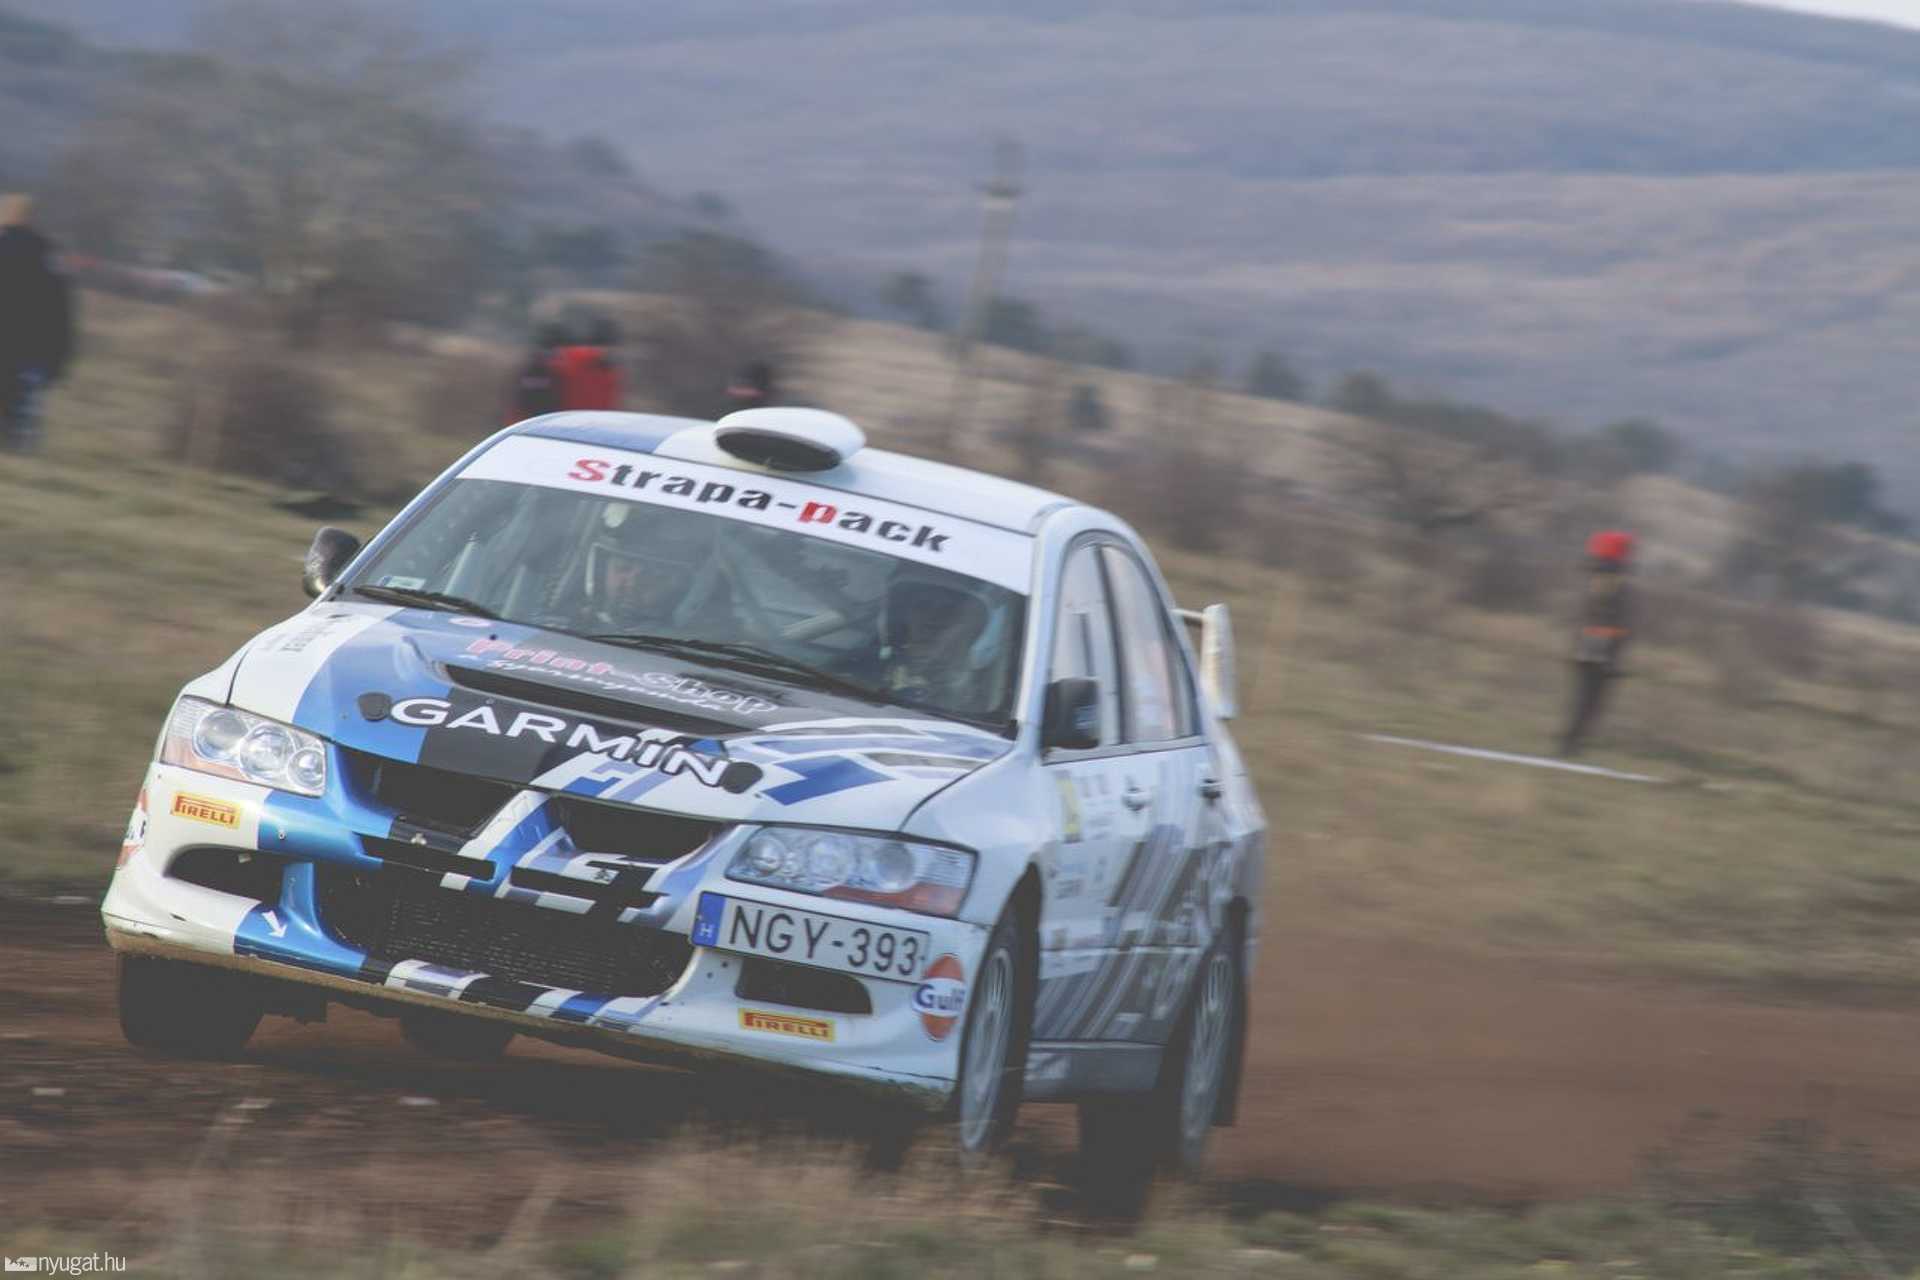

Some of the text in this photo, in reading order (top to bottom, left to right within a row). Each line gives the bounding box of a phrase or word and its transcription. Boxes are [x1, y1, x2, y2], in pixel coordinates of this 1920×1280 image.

[567, 458, 951, 552] Strapa-pack
[390, 698, 728, 788] GARMIN
[175, 795, 236, 824] PIRELLI
[729, 904, 919, 976] NGY-393
[743, 1011, 829, 1038] PIRELLI
